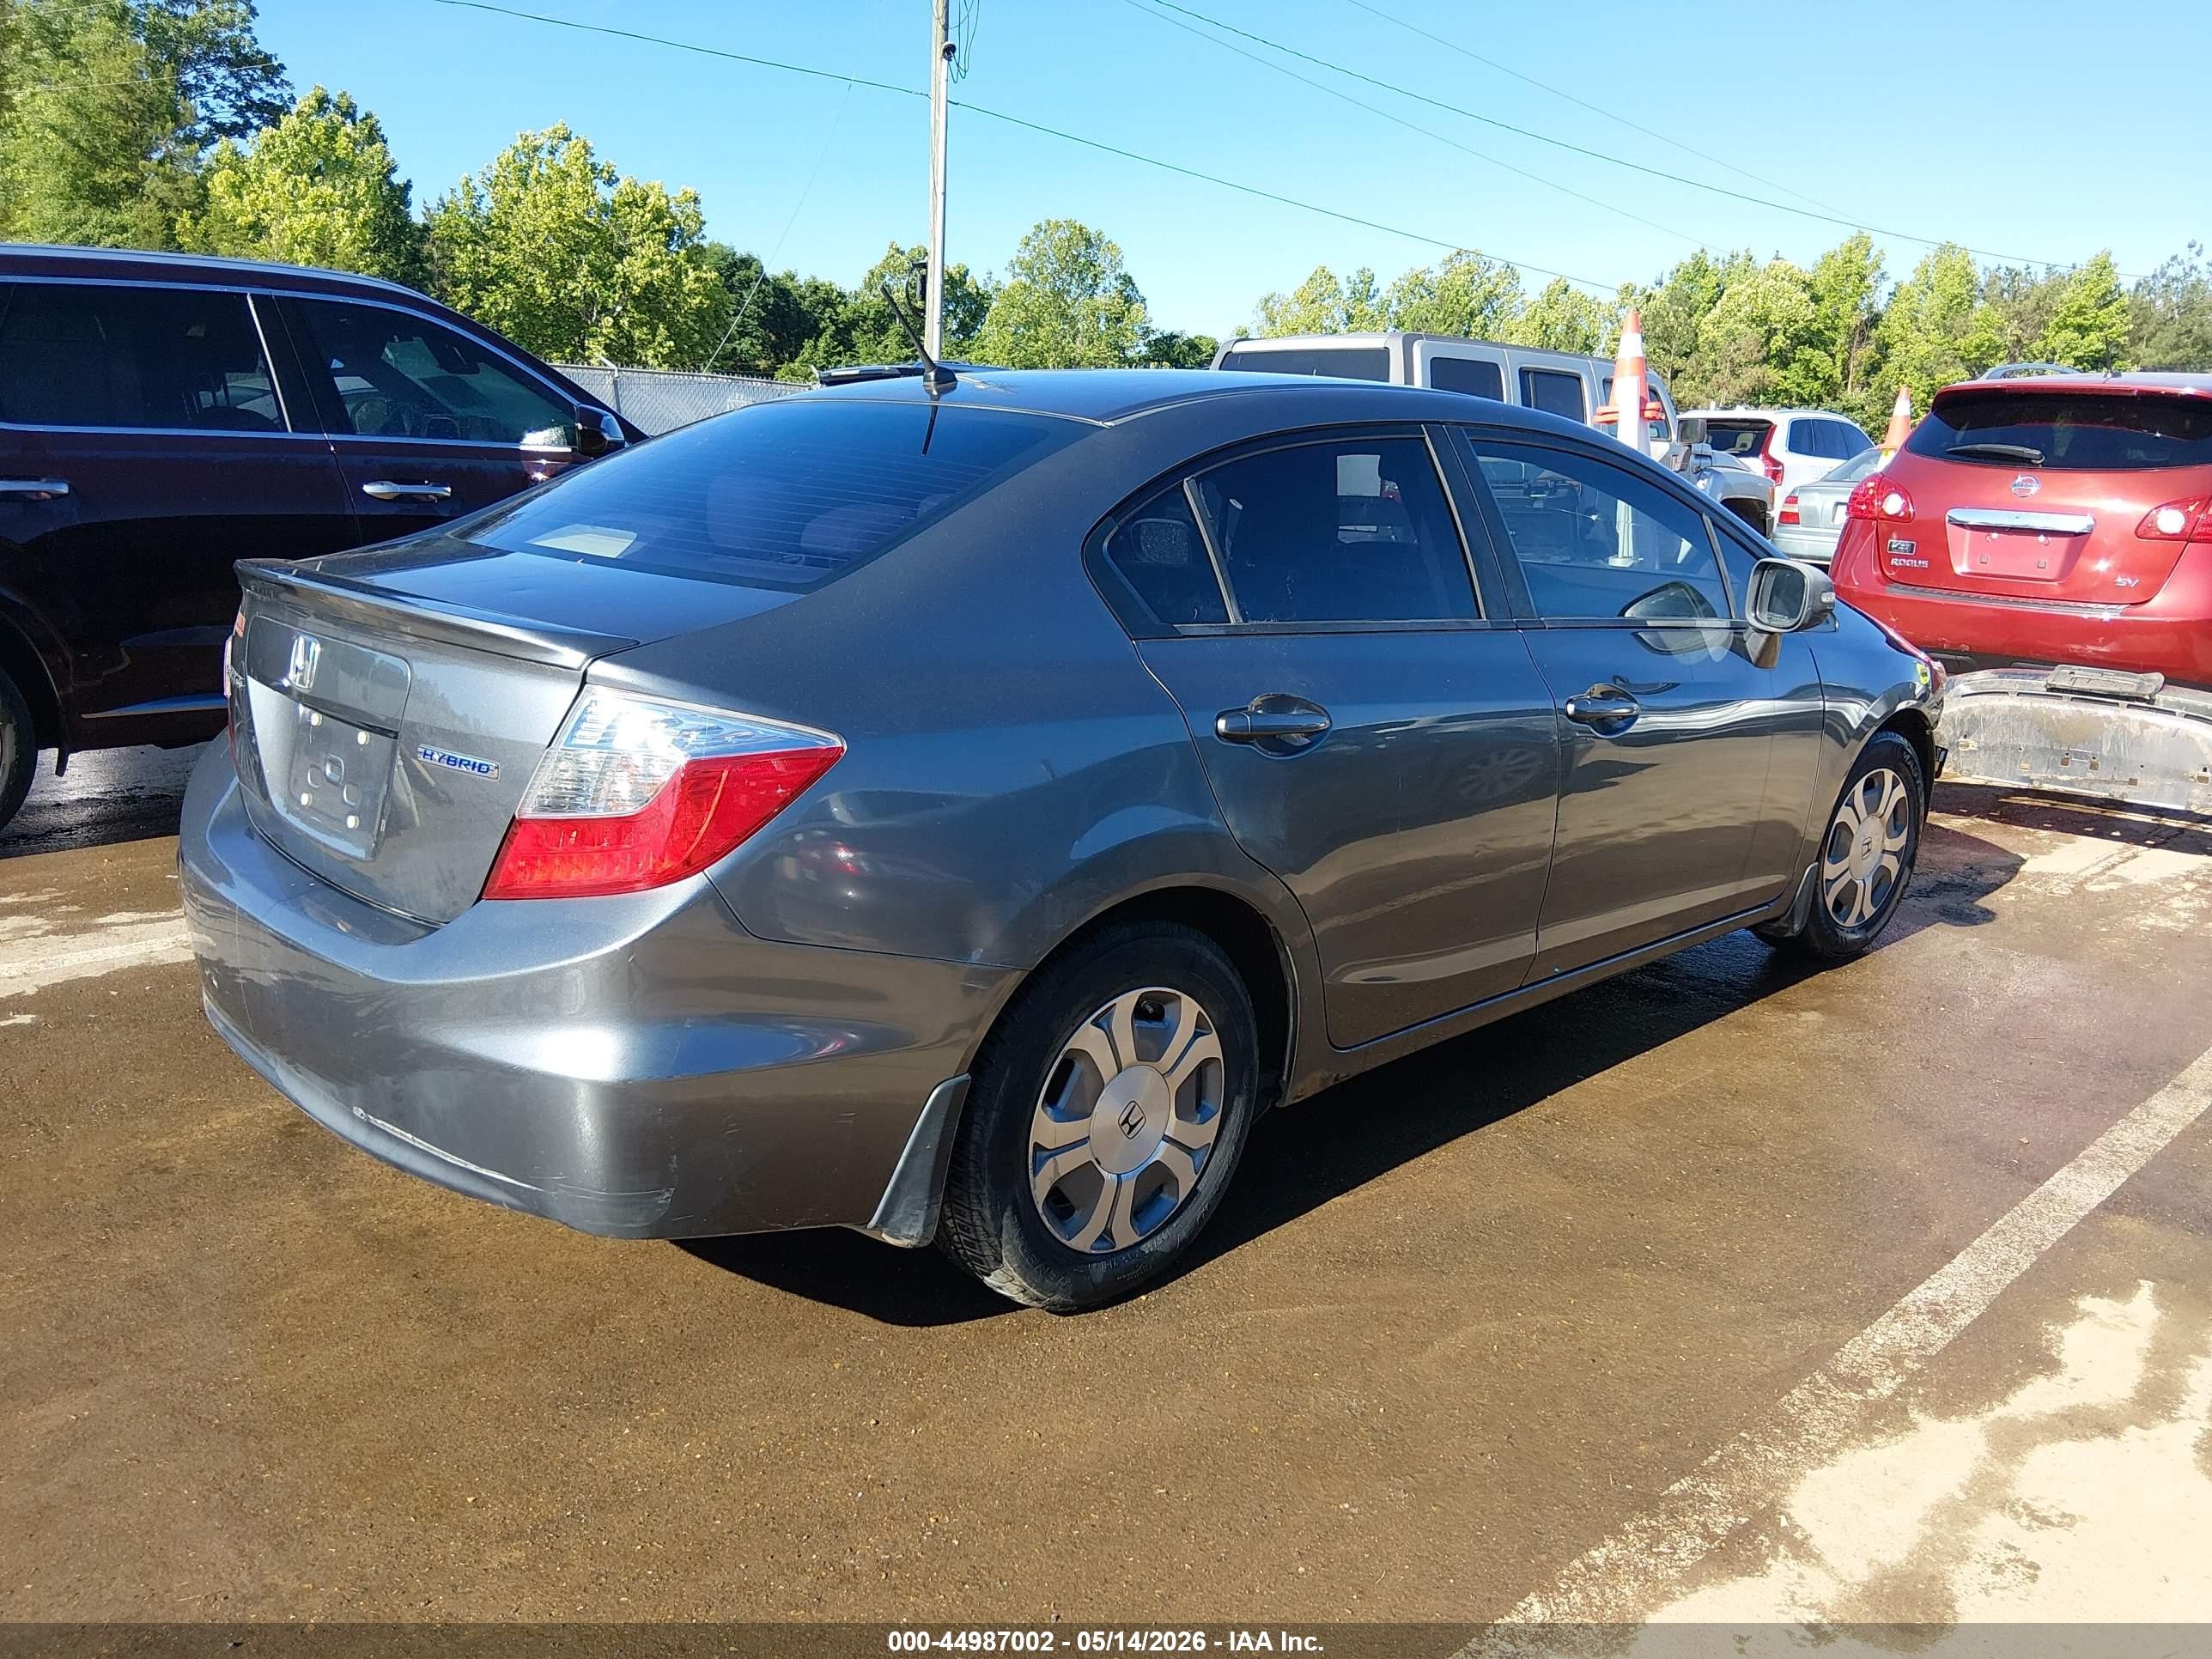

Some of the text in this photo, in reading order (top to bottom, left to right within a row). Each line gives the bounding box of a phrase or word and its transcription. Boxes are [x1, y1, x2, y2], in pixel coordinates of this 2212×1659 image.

[1890, 557, 1929, 568] ROGUE
[2115, 576, 2140, 587] SV
[422, 749, 490, 774] HYBRID
